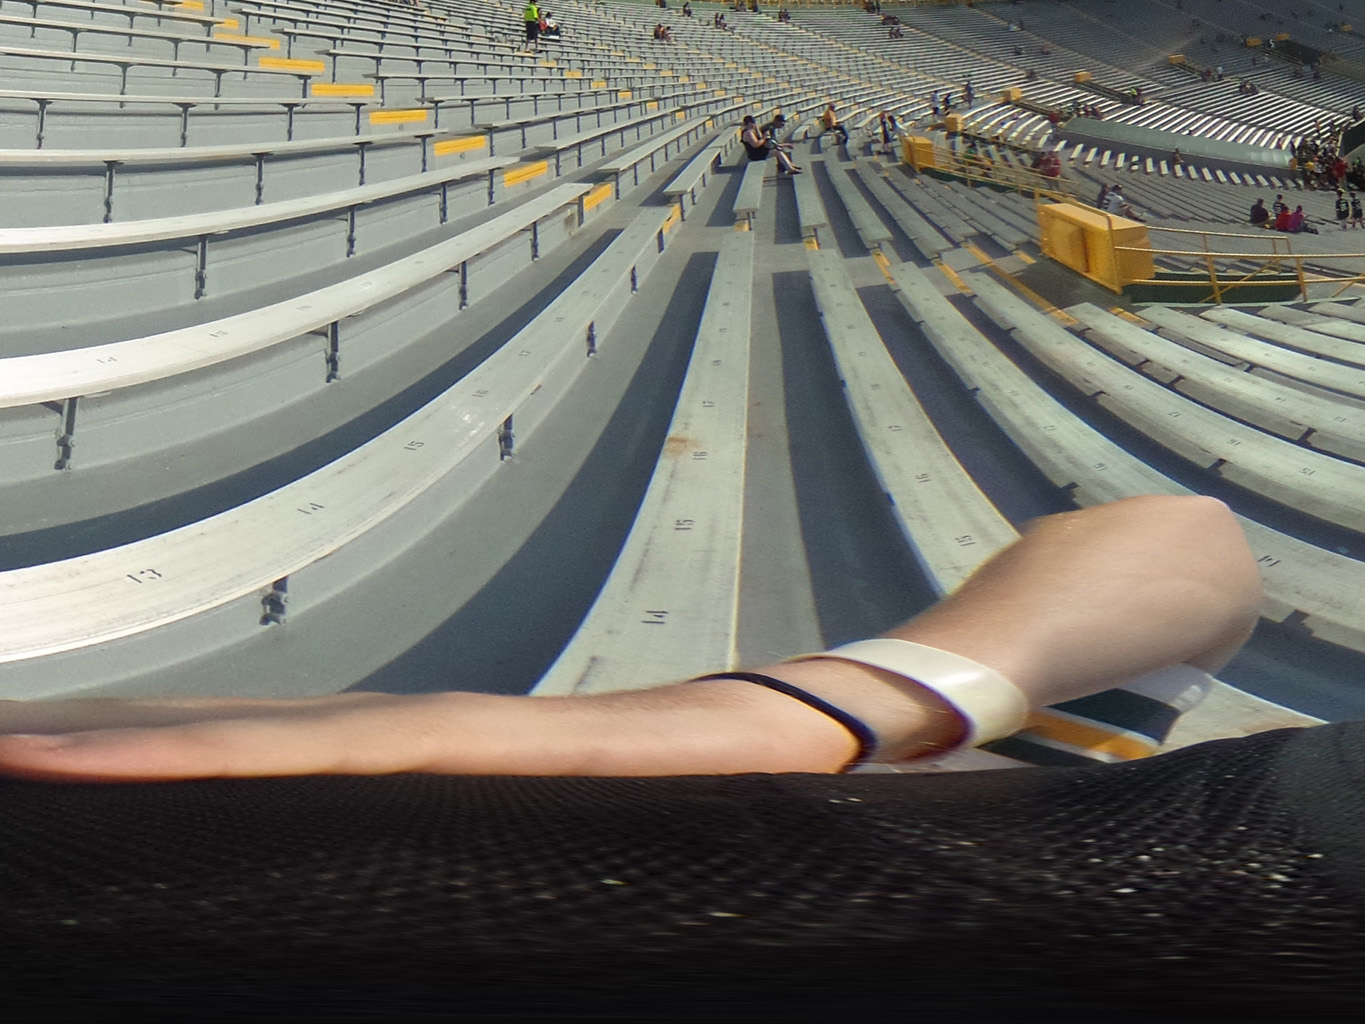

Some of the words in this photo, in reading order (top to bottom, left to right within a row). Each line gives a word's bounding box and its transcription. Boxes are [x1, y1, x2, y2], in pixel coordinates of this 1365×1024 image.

[404, 440, 425, 451] 15
[914, 472, 932, 484] 16
[297, 502, 325, 516] 14
[674, 518, 697, 531] 15
[955, 535, 977, 547] 15
[127, 568, 163, 584] 13
[640, 610, 670, 626] 14
